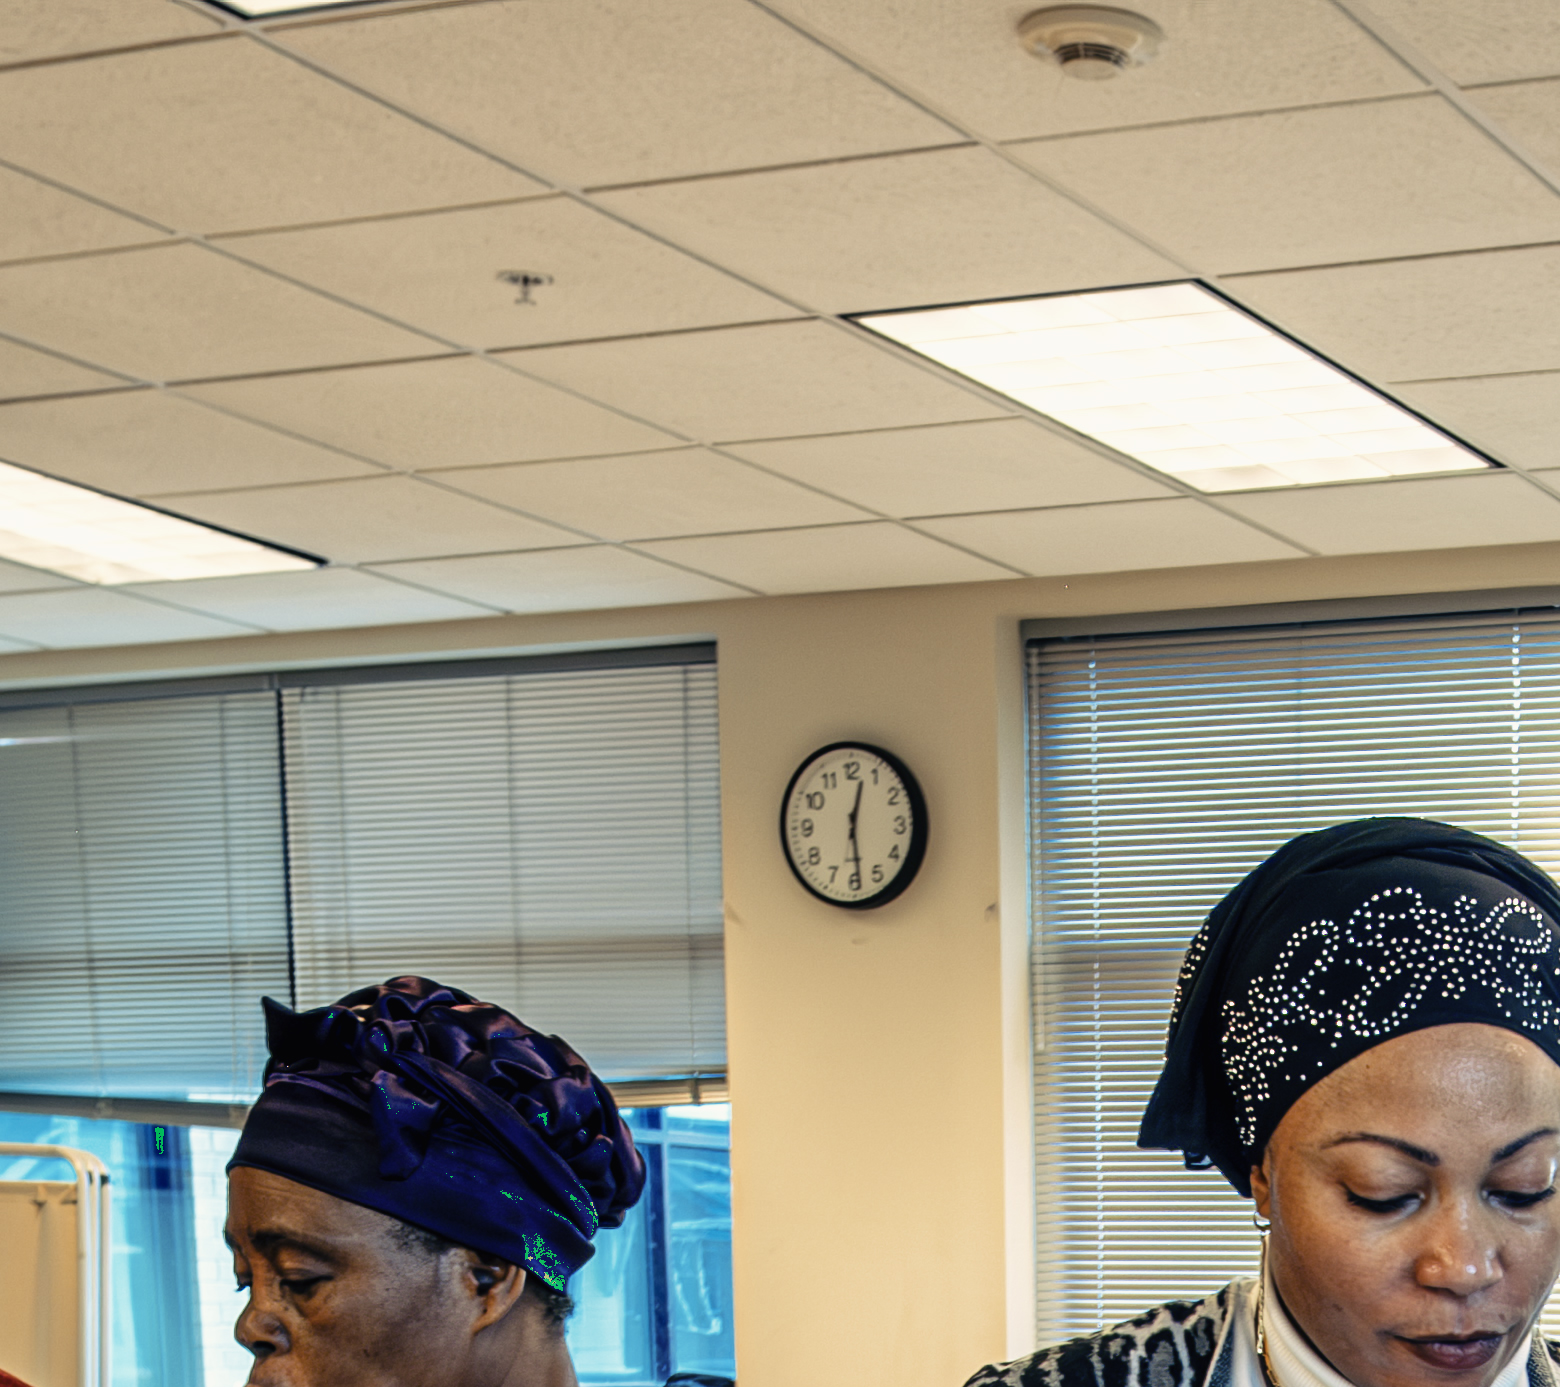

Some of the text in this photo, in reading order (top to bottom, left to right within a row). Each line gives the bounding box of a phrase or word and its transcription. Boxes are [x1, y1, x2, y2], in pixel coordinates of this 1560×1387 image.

[823, 772, 837, 789] 11
[843, 761, 860, 781] 12
[871, 769, 879, 785] 1
[806, 792, 825, 810] 10
[888, 787, 899, 806] 2
[801, 819, 813, 838] 9
[894, 816, 907, 835] 3
[809, 846, 821, 866] 8
[888, 844, 900, 862] 4
[828, 866, 839, 884] 7
[849, 872, 861, 891] 6
[871, 865, 884, 884] 5
